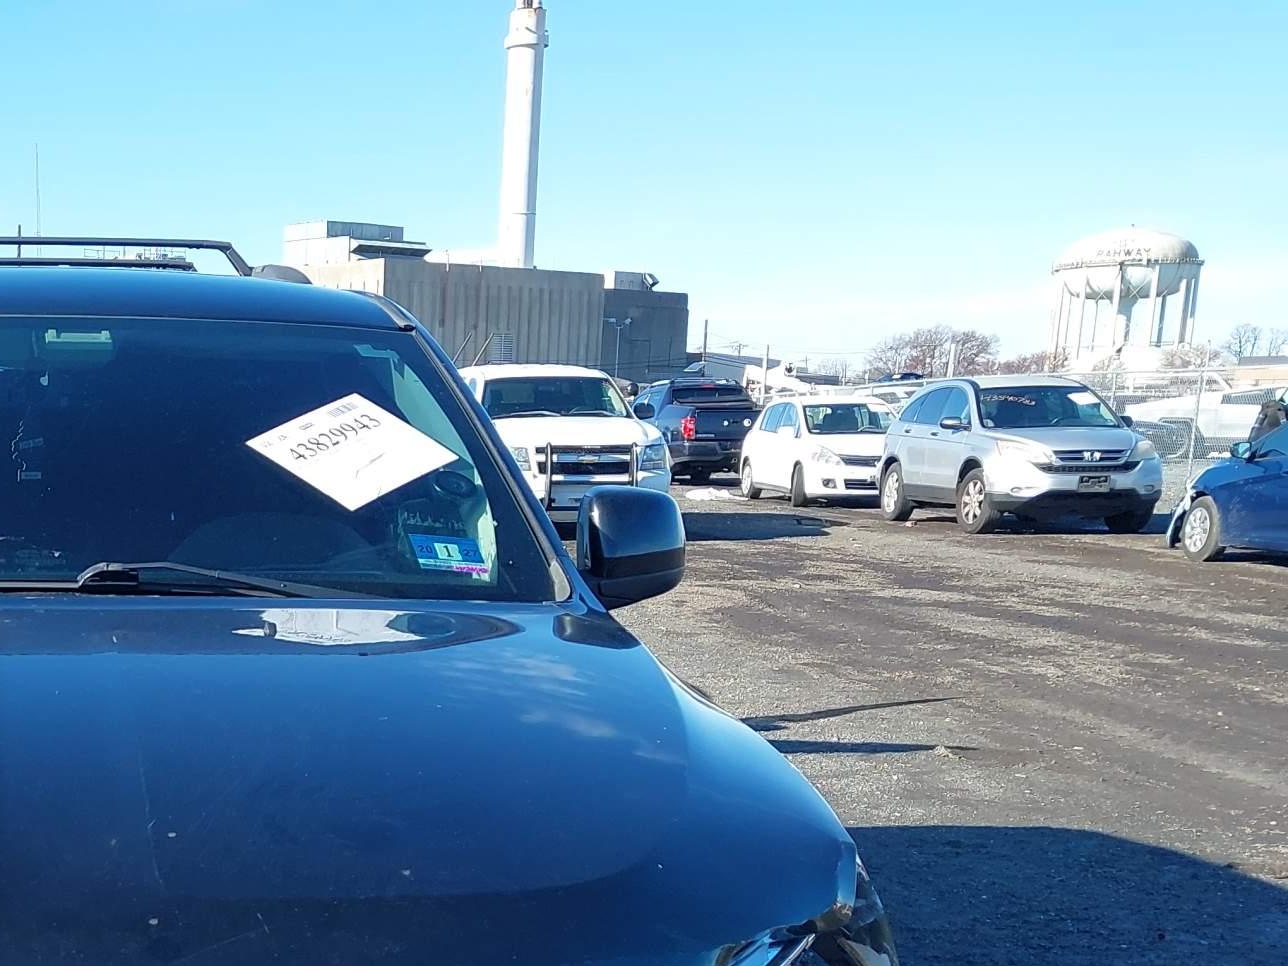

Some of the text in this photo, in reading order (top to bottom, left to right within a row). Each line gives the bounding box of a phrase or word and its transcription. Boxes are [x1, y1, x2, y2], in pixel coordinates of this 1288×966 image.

[290, 414, 381, 460] 43829943
[418, 544, 477, 558] 20 1 27
